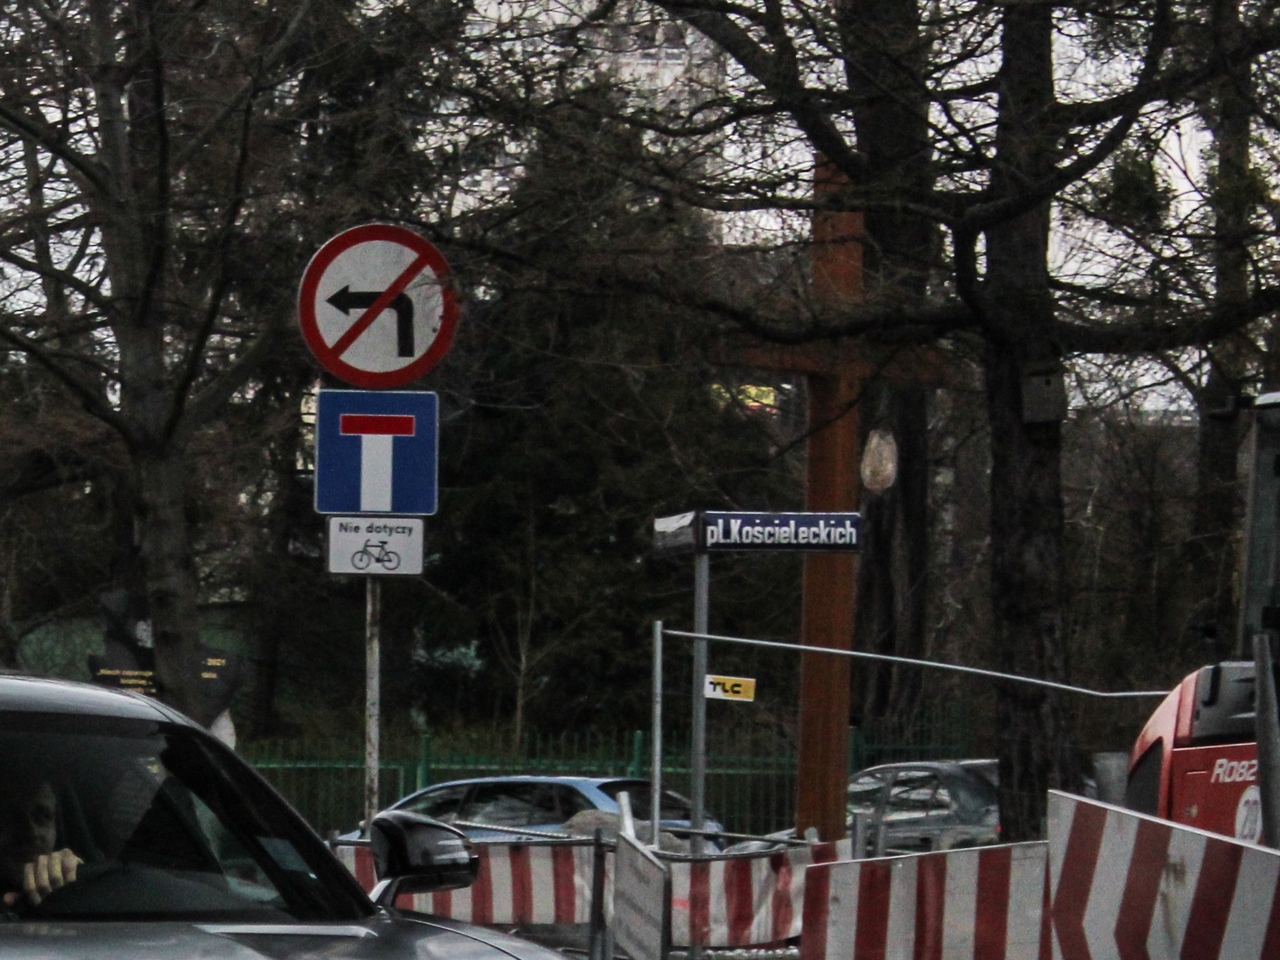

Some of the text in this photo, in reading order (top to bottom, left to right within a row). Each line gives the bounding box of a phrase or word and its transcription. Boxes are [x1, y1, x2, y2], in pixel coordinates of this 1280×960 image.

[339, 522, 414, 536] Nie dotyczy
[709, 680, 743, 695] TLC
